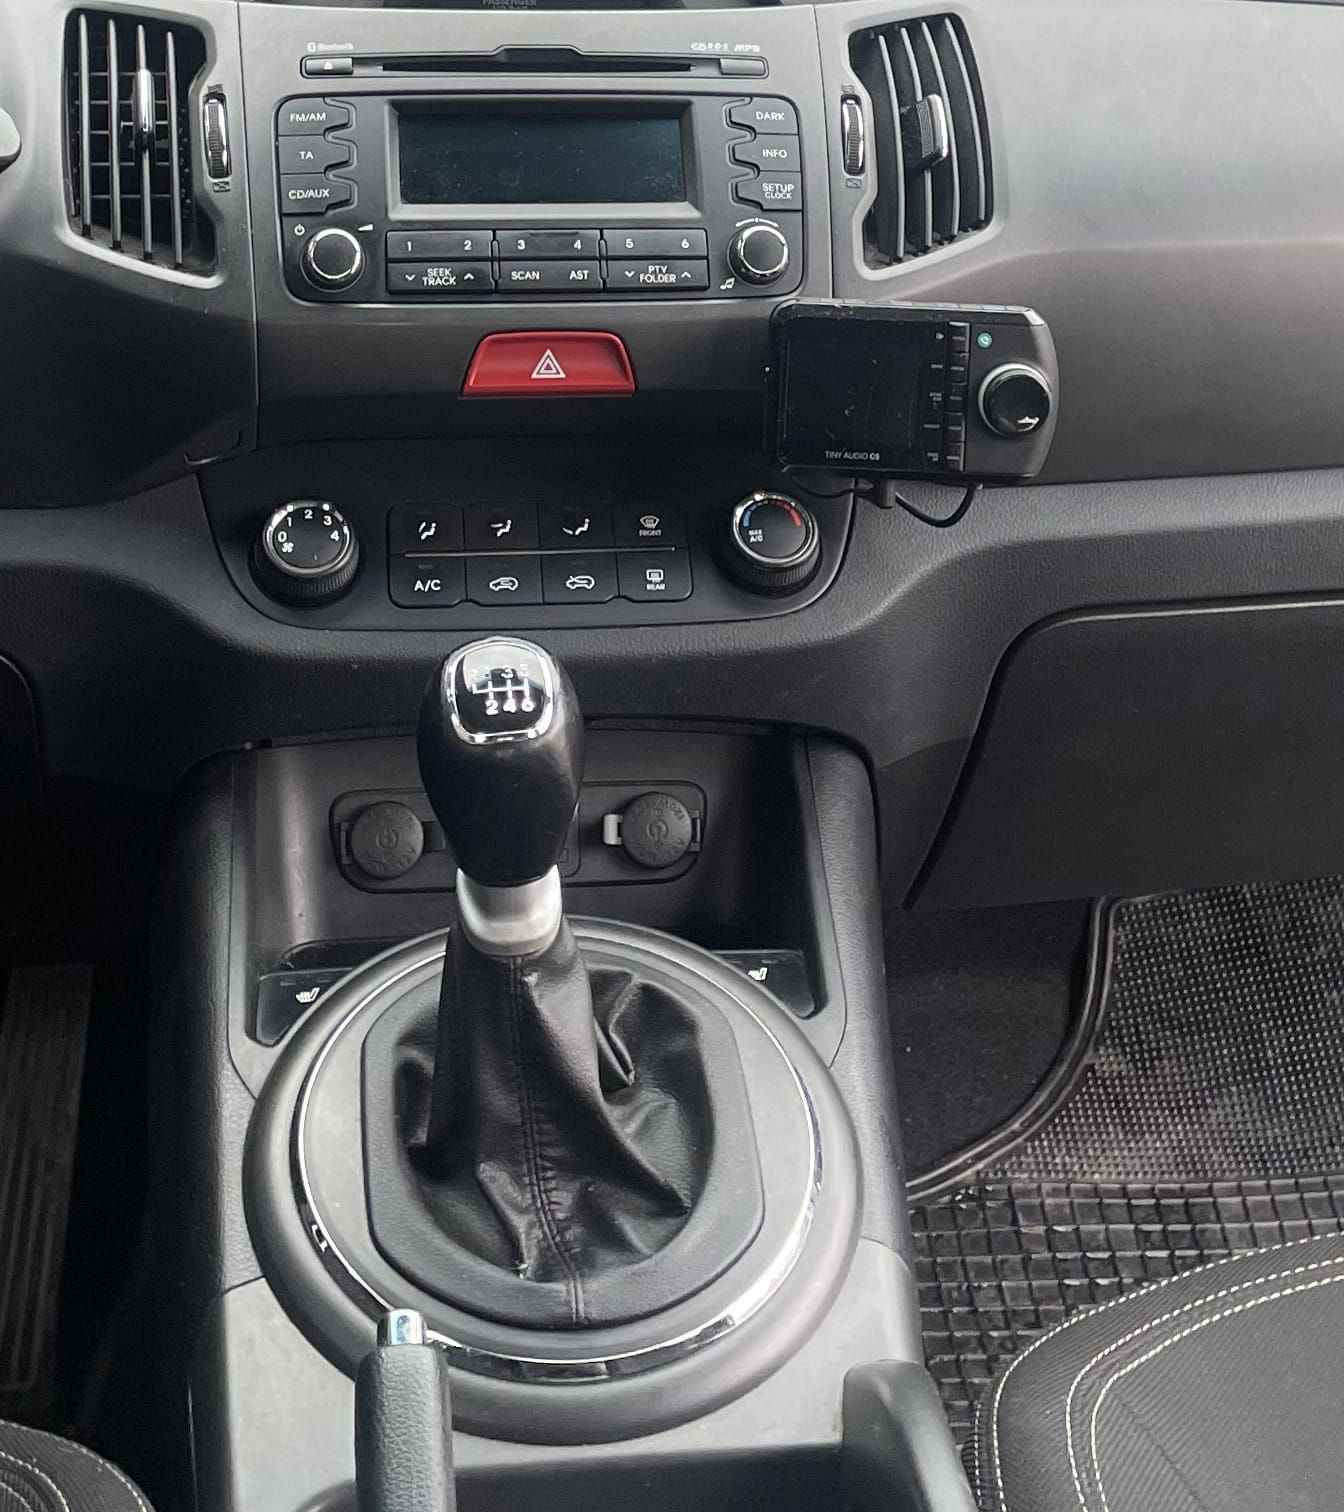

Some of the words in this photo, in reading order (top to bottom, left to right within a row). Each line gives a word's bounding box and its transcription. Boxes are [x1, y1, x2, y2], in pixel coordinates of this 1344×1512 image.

[289, 112, 327, 123] FM/AM
[755, 111, 785, 121] DARK
[299, 151, 314, 160] TA
[762, 148, 788, 158] INFO
[762, 182, 795, 193] SETUP
[288, 188, 330, 200] CD/AUX
[764, 191, 792, 200] CLOCK
[406, 241, 412, 252] 1
[463, 240, 472, 250] 2
[517, 239, 526, 250] 3
[573, 239, 582, 250] 4
[625, 238, 634, 249] 5
[681, 238, 690, 249] 6
[427, 268, 452, 277] SEEK
[648, 265, 668, 274] PTY
[511, 271, 540, 281] SCAN
[569, 270, 589, 281] AST
[639, 273, 677, 284] FOLDER
[422, 276, 457, 287] TRACK
[304, 509, 313, 519] 2
[286, 516, 292, 527] 1
[323, 515, 332, 526] 3
[277, 531, 287, 543] 0
[330, 529, 340, 541] 4
[414, 579, 441, 592] A/C
[501, 665, 514, 678] 3
[485, 699, 499, 715] 2
[502, 699, 517, 714] 4
[521, 698, 535, 713] 6
